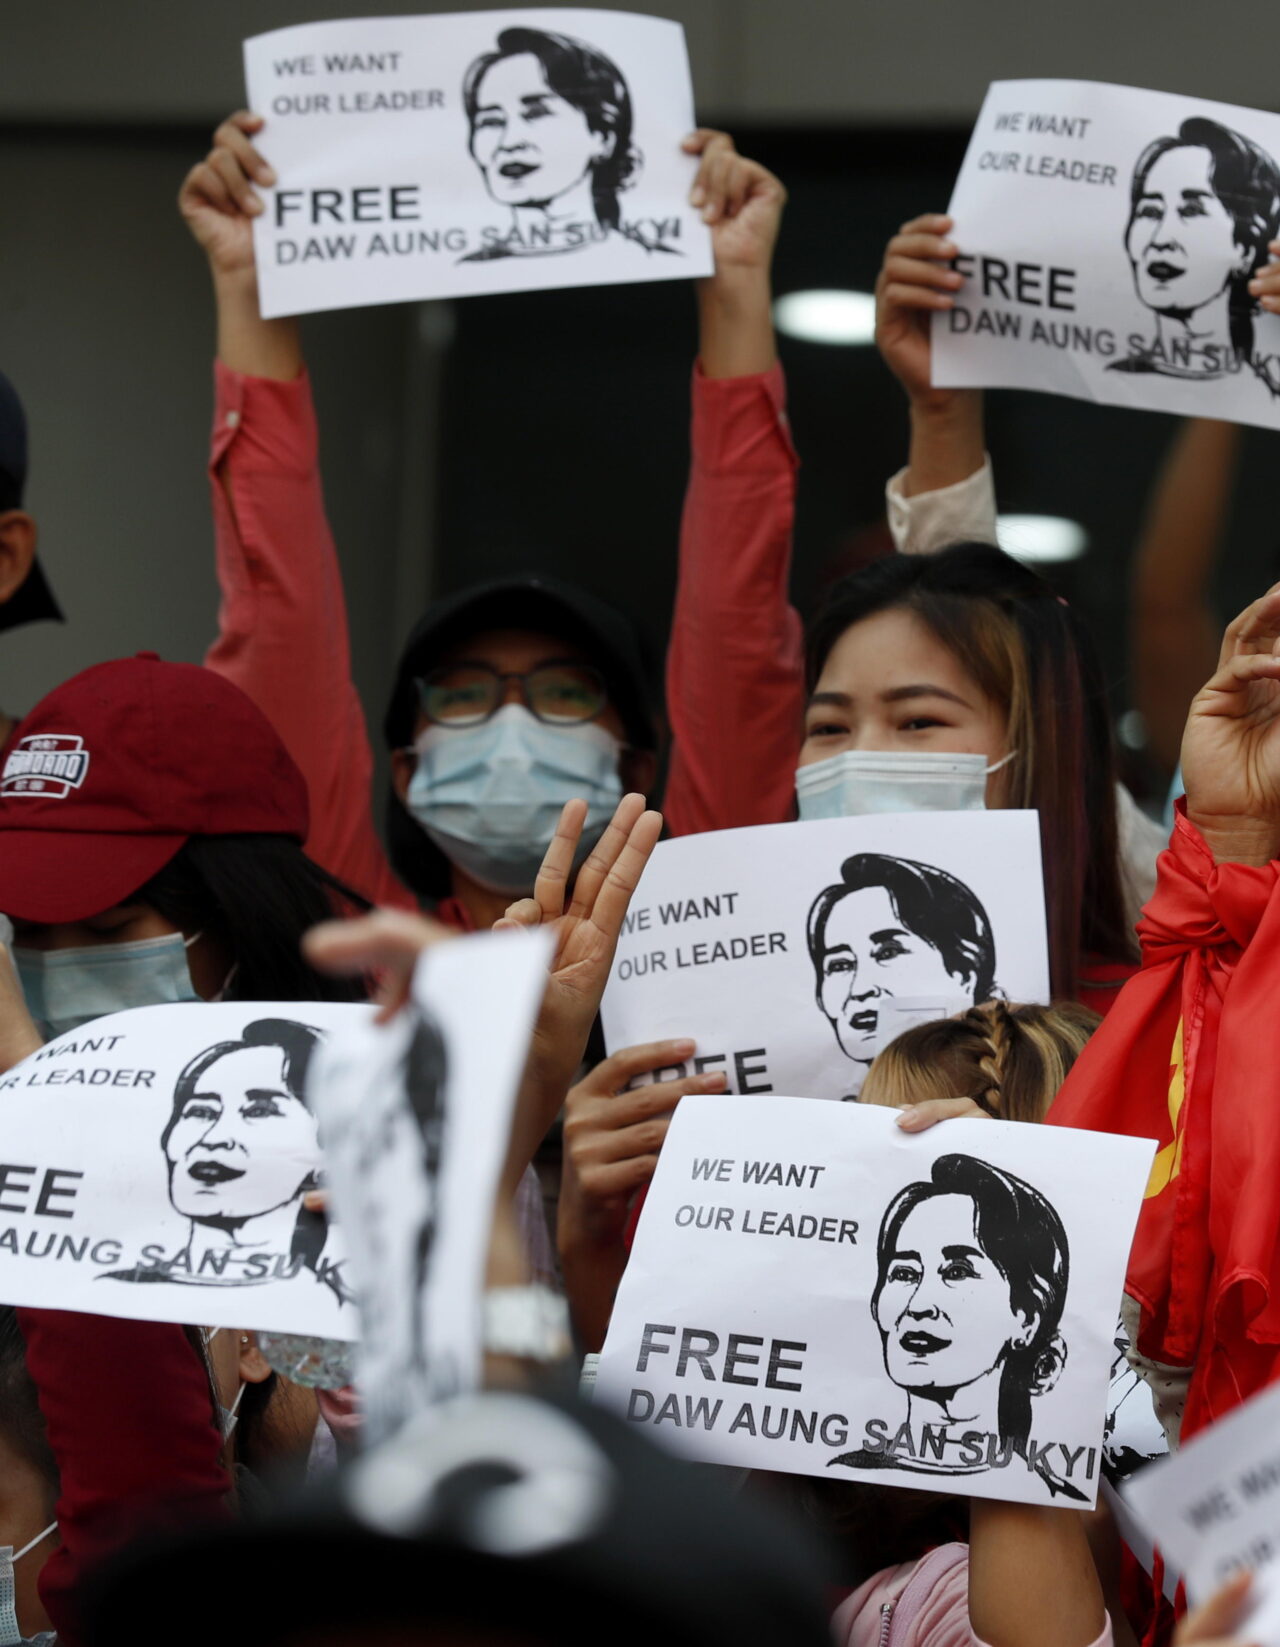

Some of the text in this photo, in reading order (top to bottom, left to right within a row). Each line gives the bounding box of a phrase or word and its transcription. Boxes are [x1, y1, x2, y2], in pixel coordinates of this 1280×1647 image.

[273, 51, 402, 77] WE WANT
[273, 89, 446, 116] OUR LEADER
[994, 112, 1092, 139] WE WANT
[978, 151, 1118, 187] OUR LEADER
[275, 186, 421, 228] FREE
[276, 216, 682, 266] DAW AUNG SAN SU KYI
[950, 254, 1076, 312] FREE
[949, 305, 1021, 340] DAW
[1031, 318, 1117, 357] AUNG
[1127, 332, 1191, 367] SAN
[1202, 342, 1244, 374] SU
[620, 892, 739, 937] WE WANT
[617, 932, 788, 981] OUR LEADER
[35, 1035, 126, 1062] WANT
[27, 1068, 156, 1089] LEADER
[0, 1163, 85, 1219] EE
[691, 1157, 826, 1189] WE WANT
[675, 1204, 860, 1245] OUR LEADER
[0, 1227, 123, 1265] AUNG
[140, 1244, 227, 1276] SAN
[243, 1252, 304, 1280] SU
[635, 1323, 808, 1392] FREE
[626, 1388, 1097, 1480] DAW AUNG SAN SU KYI
